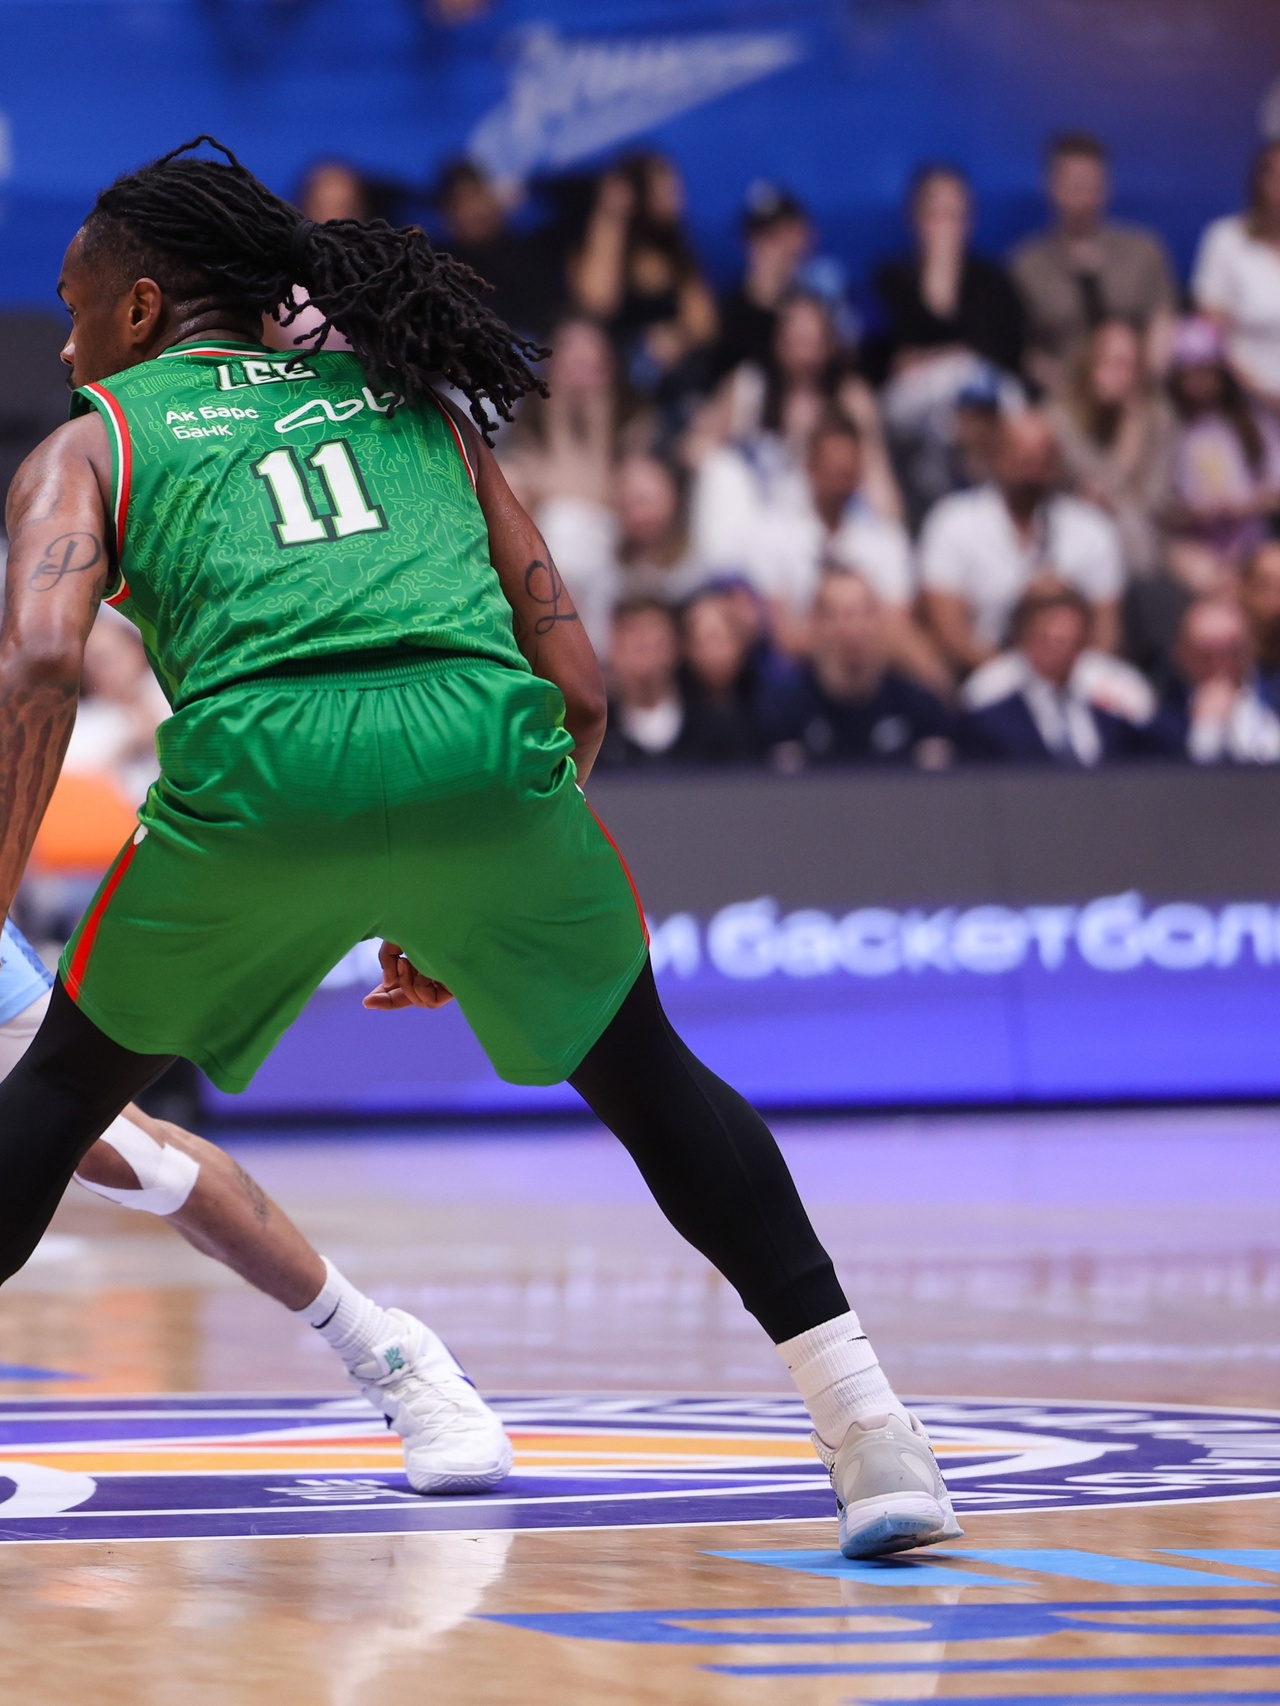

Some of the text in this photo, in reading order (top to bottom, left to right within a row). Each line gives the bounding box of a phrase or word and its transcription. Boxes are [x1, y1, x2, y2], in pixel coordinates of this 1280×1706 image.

[216, 359, 320, 391] LEE
[166, 405, 260, 424] Ак Барс
[172, 424, 234, 440] Банк
[250, 438, 389, 549] 11
